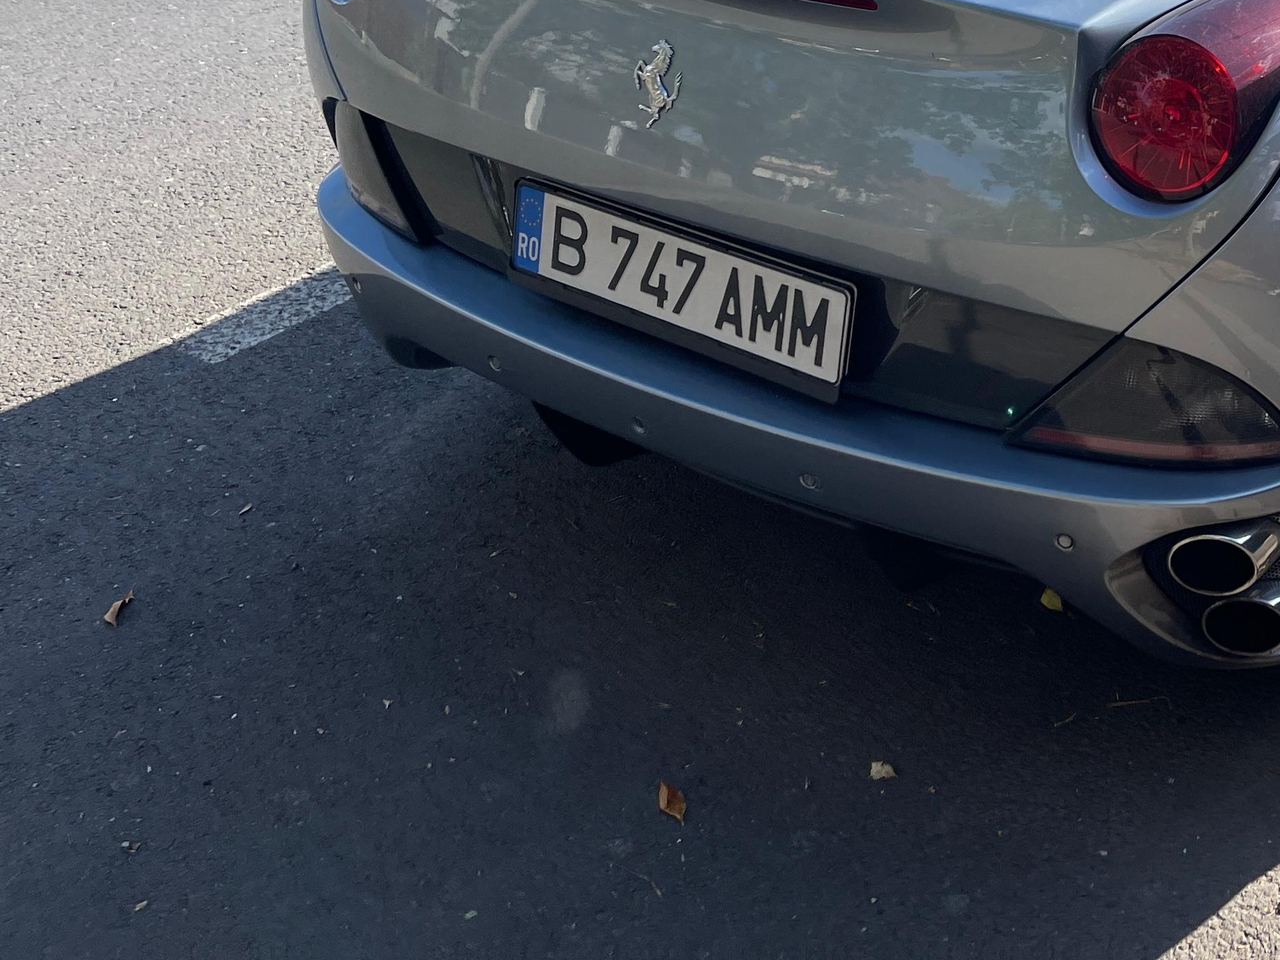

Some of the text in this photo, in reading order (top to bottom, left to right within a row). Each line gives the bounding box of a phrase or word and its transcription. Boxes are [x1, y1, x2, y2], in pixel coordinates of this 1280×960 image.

[517, 232, 539, 262] RO
[551, 205, 830, 368] B 747 AMM
